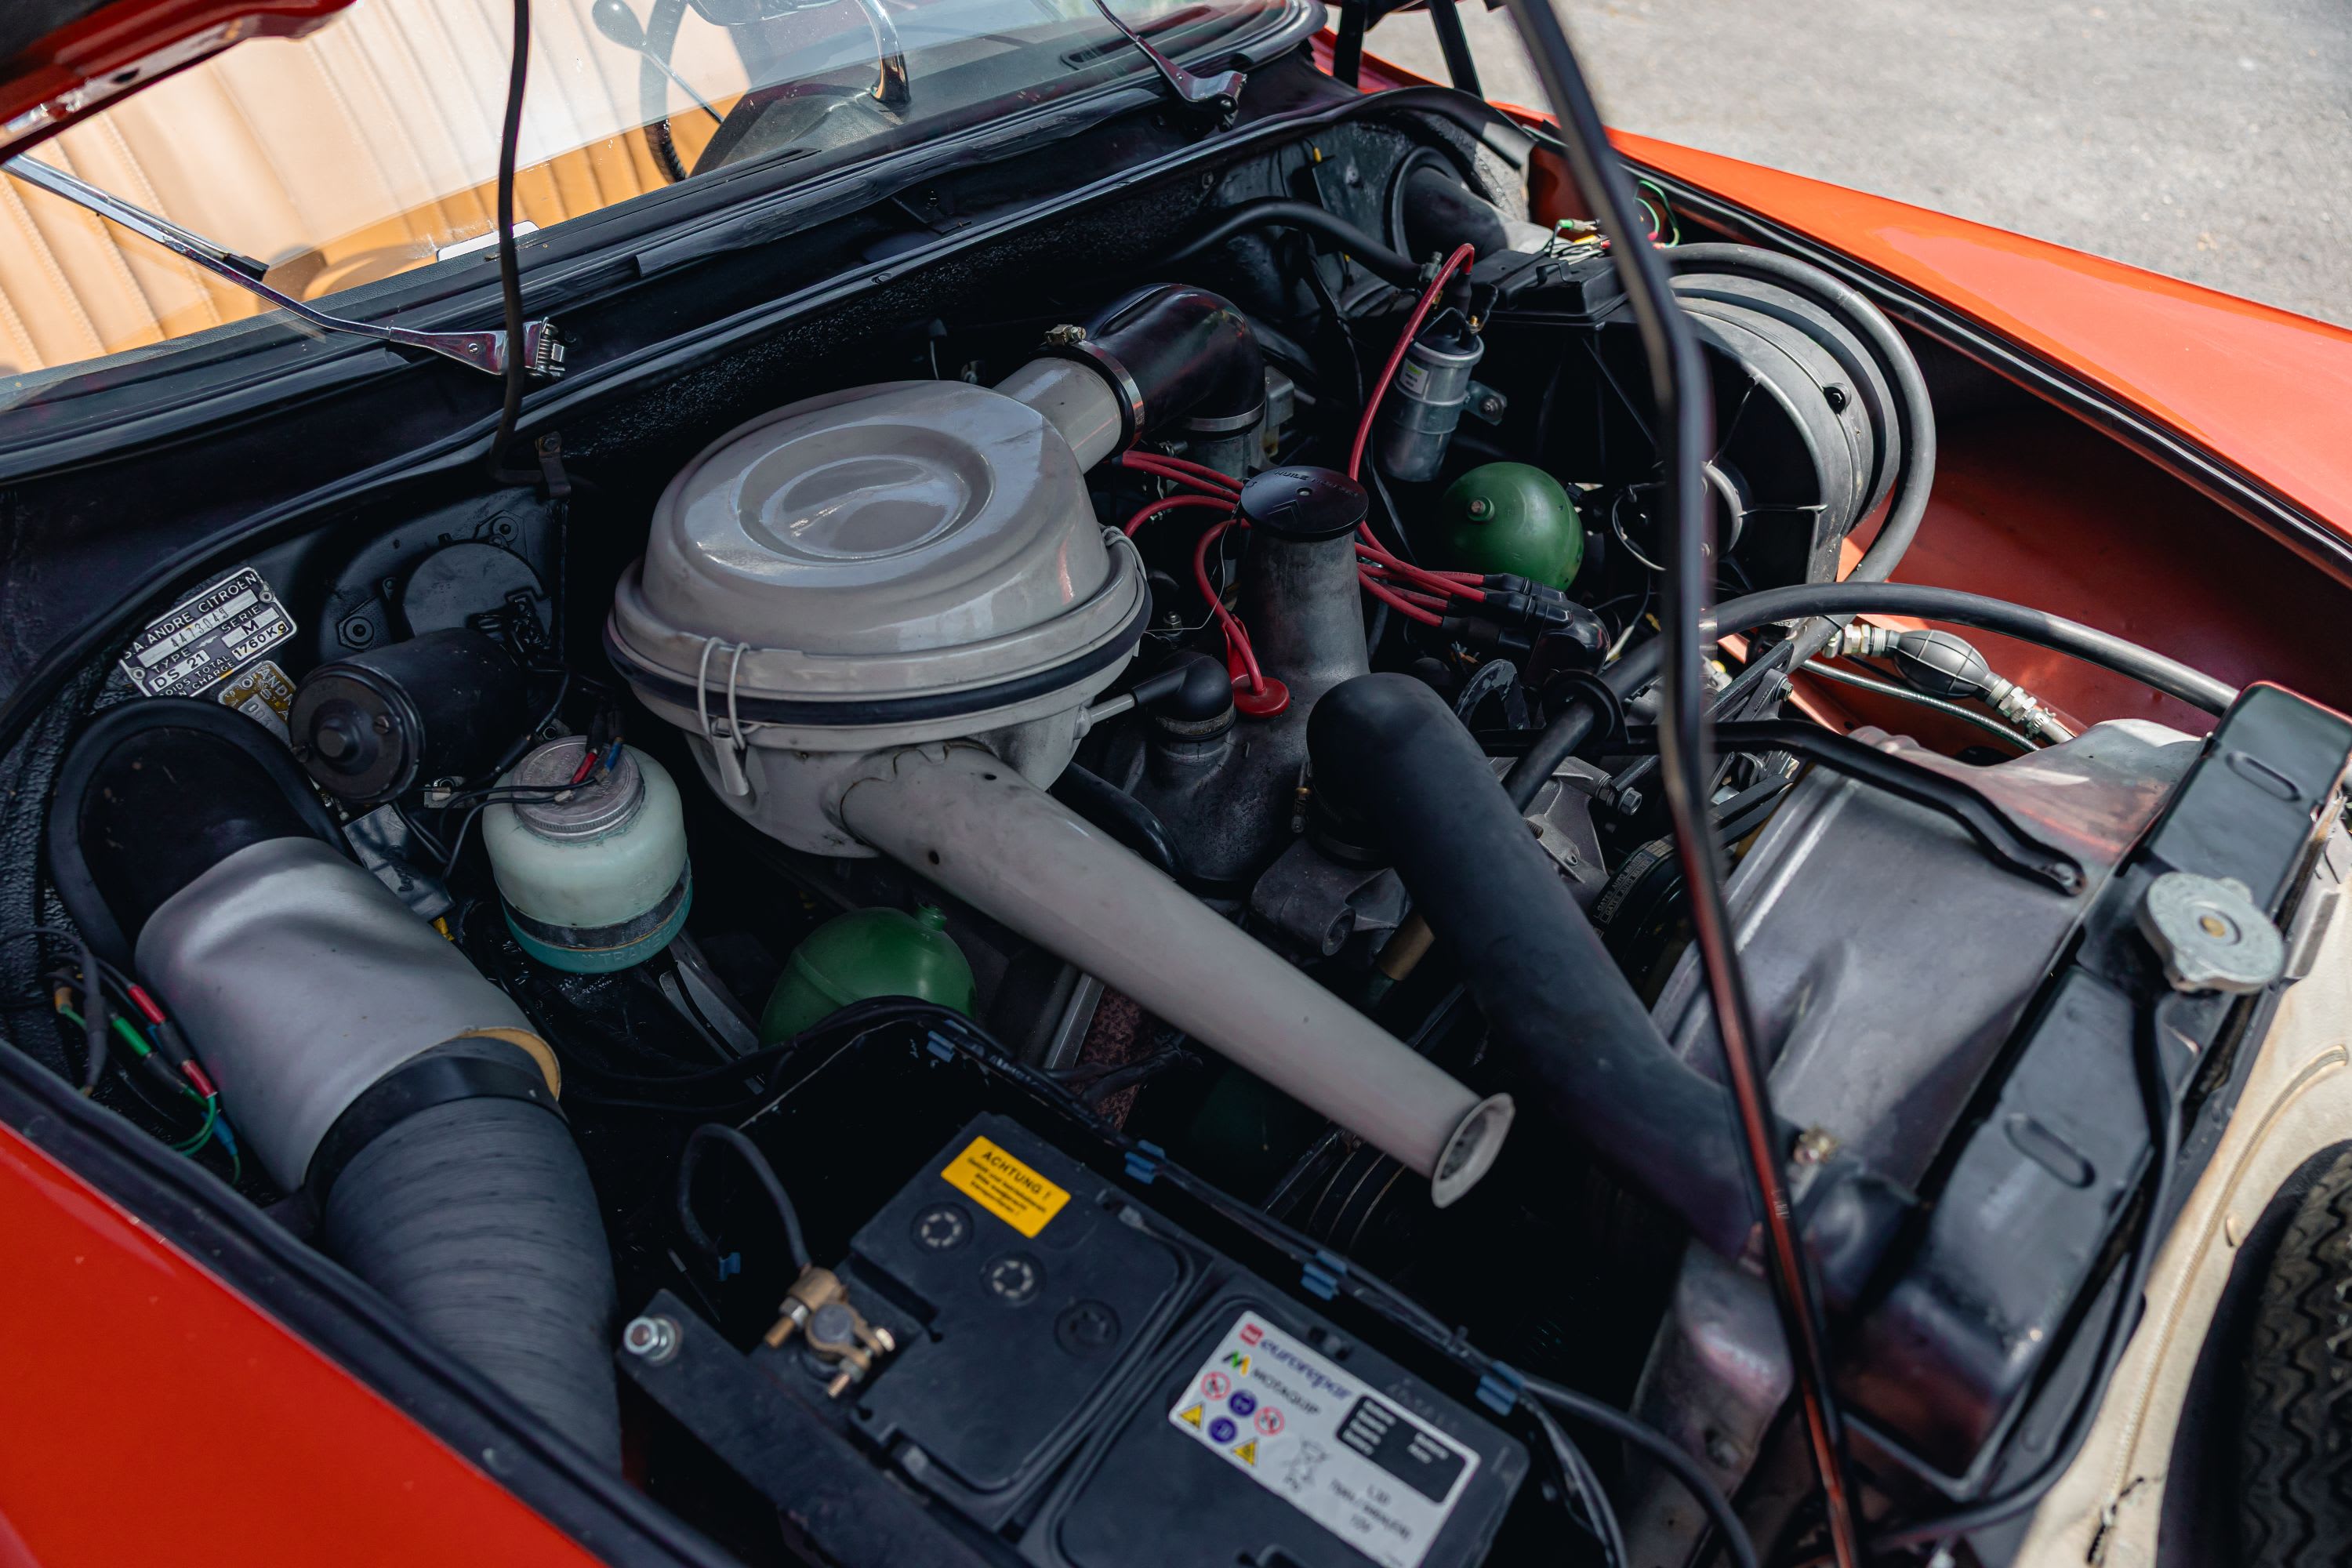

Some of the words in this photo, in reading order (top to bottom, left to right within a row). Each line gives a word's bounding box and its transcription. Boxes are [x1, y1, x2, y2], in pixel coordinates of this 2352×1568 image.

[1274, 470, 1309, 481] HUILE
[221, 604, 262, 634] SERIE
[241, 619, 260, 636] M
[151, 647, 193, 673] TYPE
[154, 668, 180, 689] DS
[187, 652, 206, 670] 21
[159, 677, 191, 696] OIDS
[194, 655, 231, 678] TOTAL
[192, 660, 235, 690] CHARGE
[1611, 873, 1625, 890] AUTO
[1619, 878, 1634, 895] AUTO
[982, 1152, 1043, 1195] ACHTUNG
